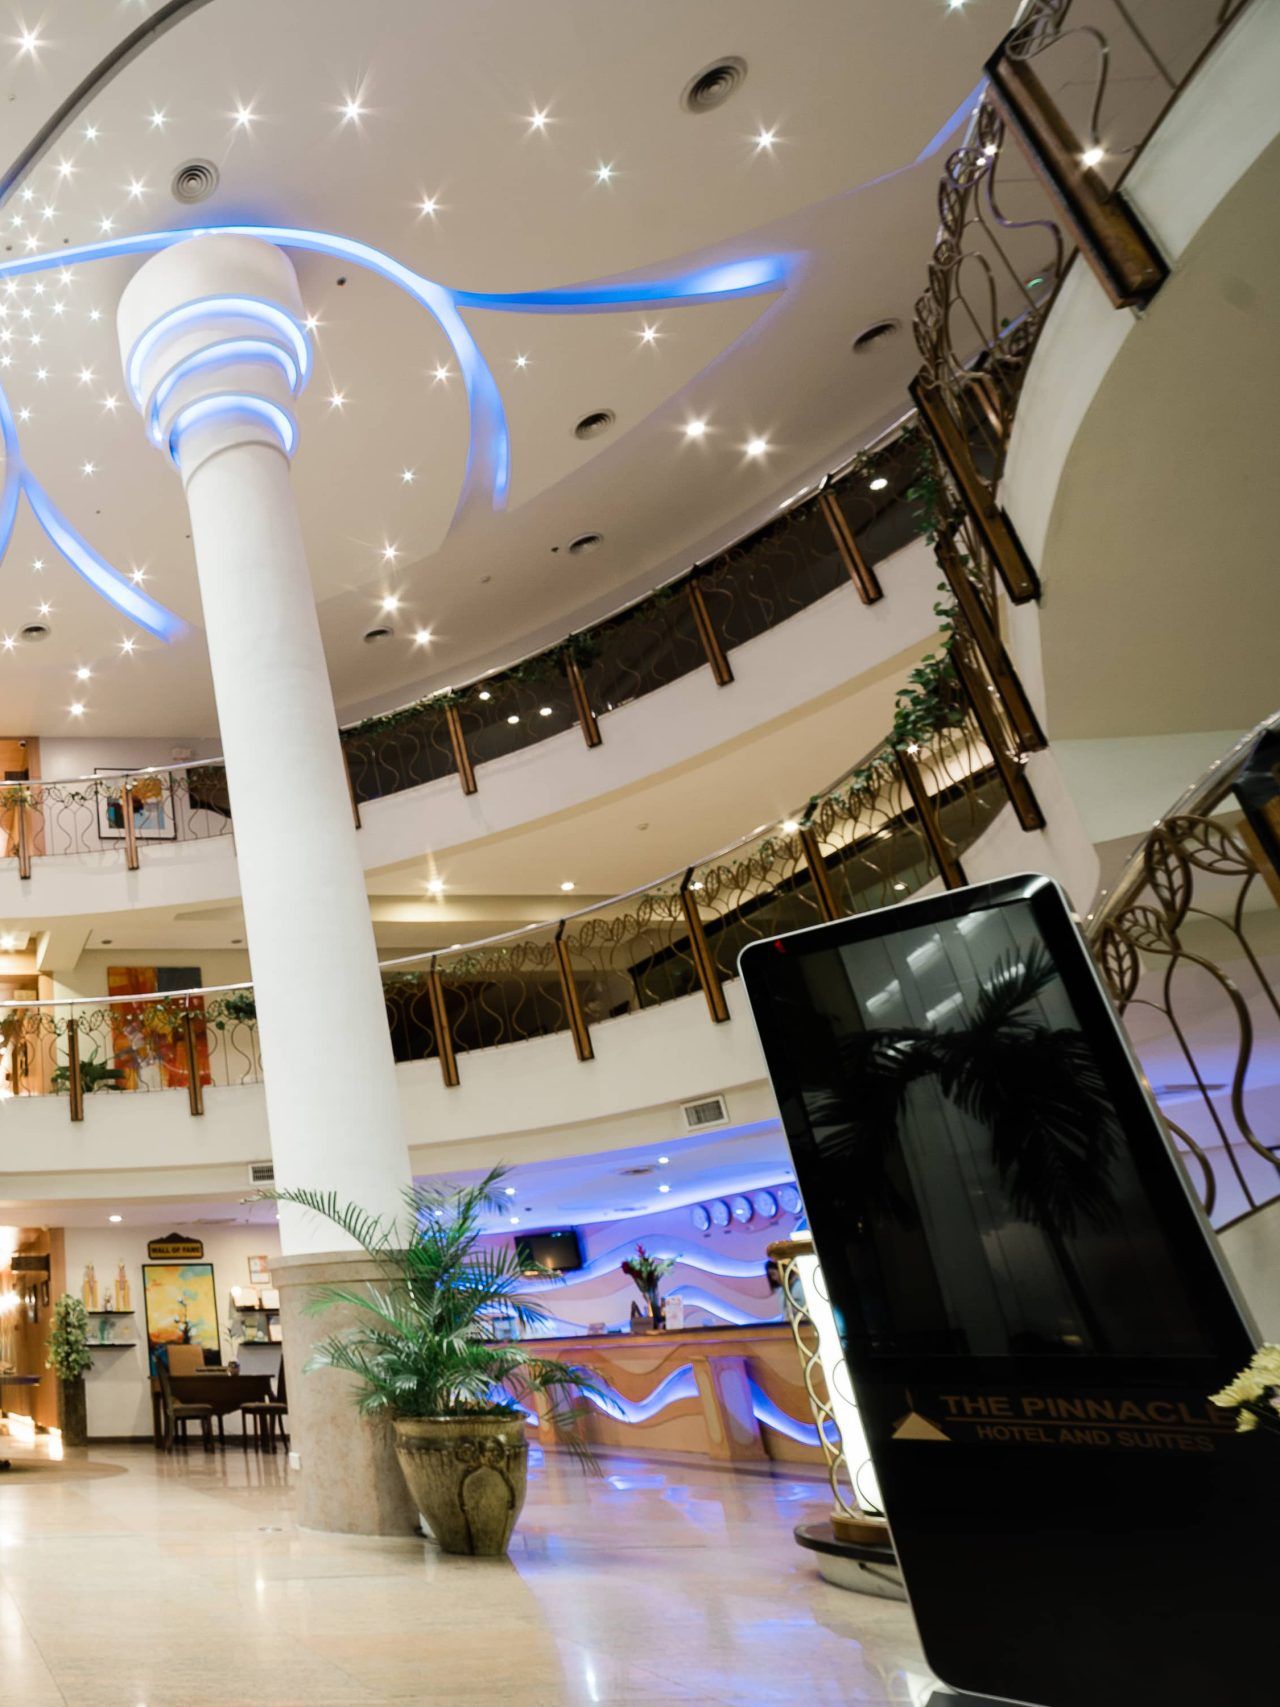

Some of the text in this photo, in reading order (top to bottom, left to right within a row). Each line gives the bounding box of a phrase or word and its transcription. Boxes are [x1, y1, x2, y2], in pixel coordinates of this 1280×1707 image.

[151, 1246, 200, 1254] WALL OF FAME
[938, 1394, 1237, 1426] THE PINNACLE
[975, 1424, 1217, 1453] HOTEL AND SUITES
